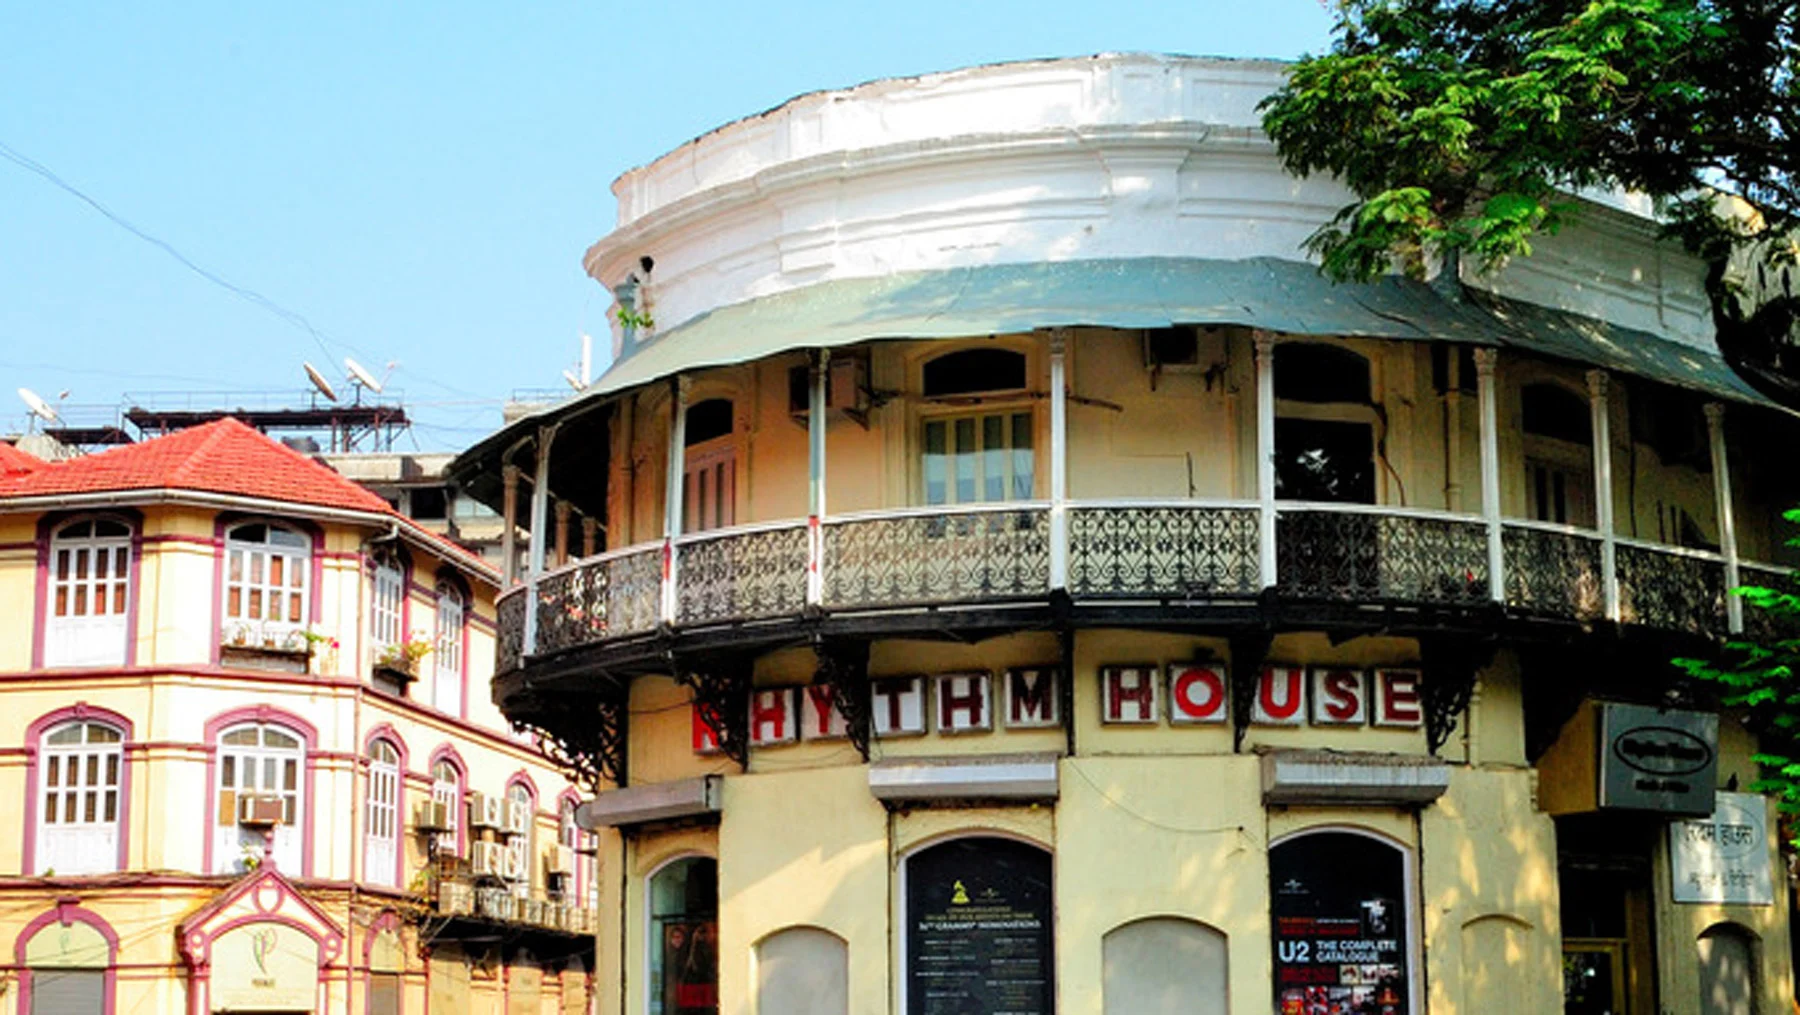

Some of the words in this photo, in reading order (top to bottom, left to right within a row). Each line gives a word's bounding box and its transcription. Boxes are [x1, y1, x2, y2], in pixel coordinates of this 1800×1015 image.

[692, 667, 1052, 749] RHYTHM
[1109, 667, 1421, 721] HOUSE
[1278, 940, 1310, 963] U2
[1316, 940, 1337, 950] THE
[1339, 940, 1397, 951] COMPLETE
[1315, 951, 1379, 963] CATALOGUE
